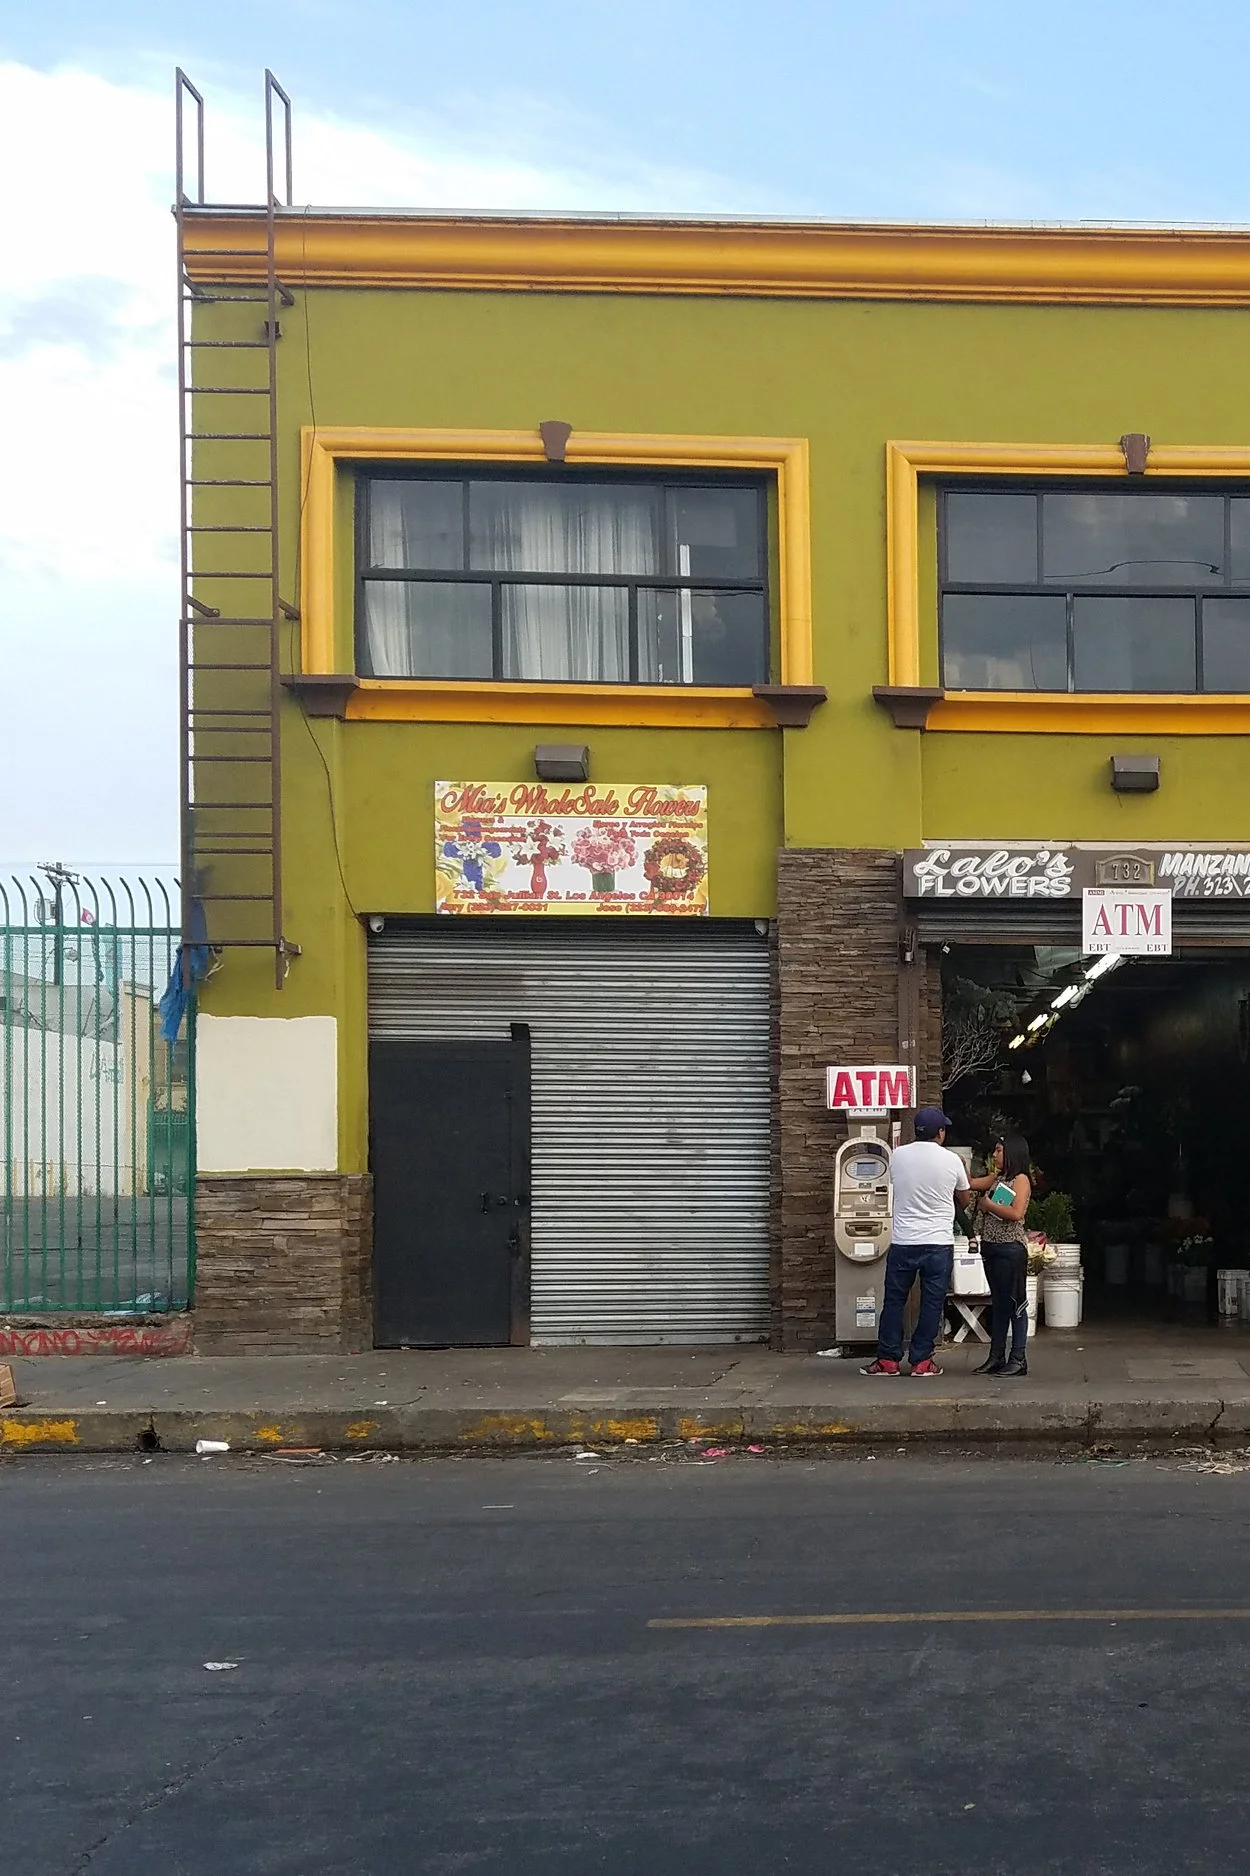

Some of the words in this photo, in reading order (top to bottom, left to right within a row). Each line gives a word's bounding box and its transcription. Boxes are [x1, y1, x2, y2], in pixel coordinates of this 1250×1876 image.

[441, 784, 507, 814] Mia's
[509, 784, 619, 815] WholeSale
[624, 786, 701, 816] Flowers
[913, 849, 1075, 878] Lalo's
[1112, 863, 1140, 880] 732
[565, 891, 587, 900] Los
[918, 875, 1072, 898] FLOWERS
[1172, 876, 1200, 897] PH.
[1091, 903, 1164, 936] ATM
[1089, 943, 1111, 952] EBT
[1146, 943, 1168, 952] EBT
[832, 1071, 909, 1107] ATM
